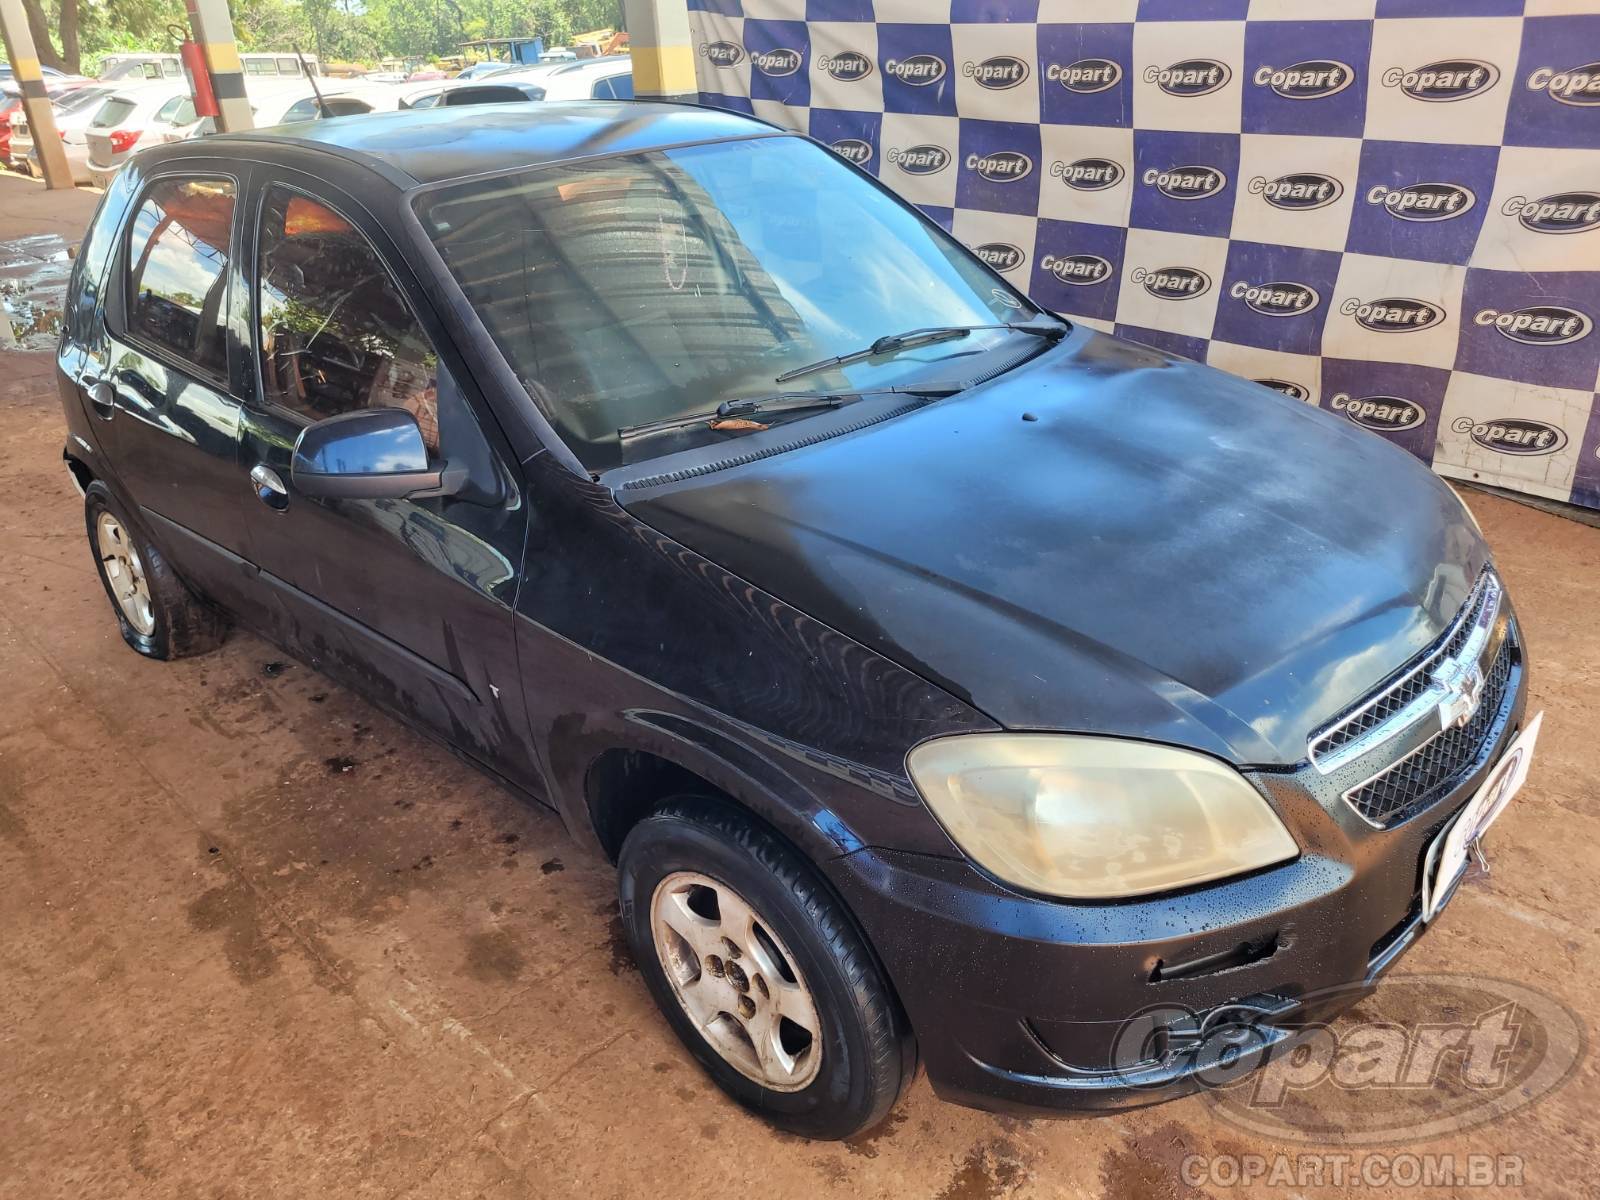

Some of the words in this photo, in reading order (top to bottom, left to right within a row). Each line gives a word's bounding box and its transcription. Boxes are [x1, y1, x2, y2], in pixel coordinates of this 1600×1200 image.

[751, 52, 794, 70] Copart
[818, 55, 868, 74] Copart
[886, 59, 940, 78] Copart
[962, 62, 1021, 82] Copart
[1047, 65, 1113, 85] Copart
[1143, 65, 1219, 87] Copart
[1254, 66, 1341, 90] Copart
[1381, 67, 1483, 92] Copart
[1527, 67, 1600, 97] Copa
[832, 145, 866, 160] part
[887, 148, 943, 167] Copart
[966, 155, 1024, 175] Copart
[1050, 161, 1115, 185] Copart
[1143, 169, 1217, 191] Copart
[1248, 176, 1330, 201] Copart
[1367, 186, 1462, 212] Copart
[1501, 196, 1600, 223] Copart
[1041, 255, 1103, 278] Copart
[1131, 267, 1200, 291] Copart
[1230, 282, 1309, 310] Copart
[1340, 298, 1431, 326] Copart
[1473, 309, 1580, 338] Copart
[1331, 393, 1415, 425] Copart
[1452, 417, 1554, 449] Copart
